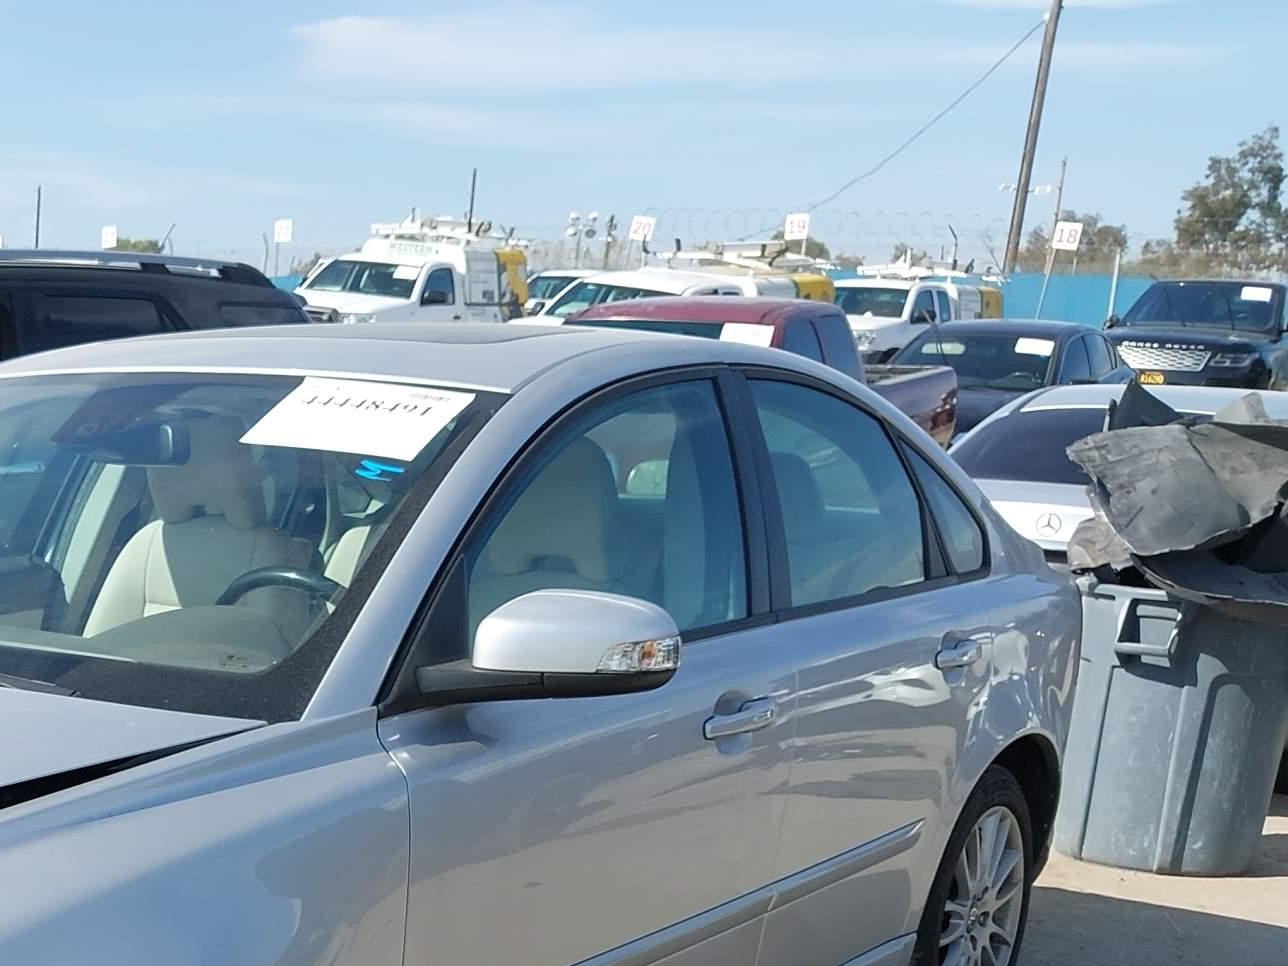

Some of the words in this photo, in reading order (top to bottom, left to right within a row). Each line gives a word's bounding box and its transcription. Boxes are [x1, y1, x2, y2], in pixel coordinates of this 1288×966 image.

[632, 221, 651, 235] 20
[789, 219, 807, 234] 19
[1055, 228, 1078, 244] 18
